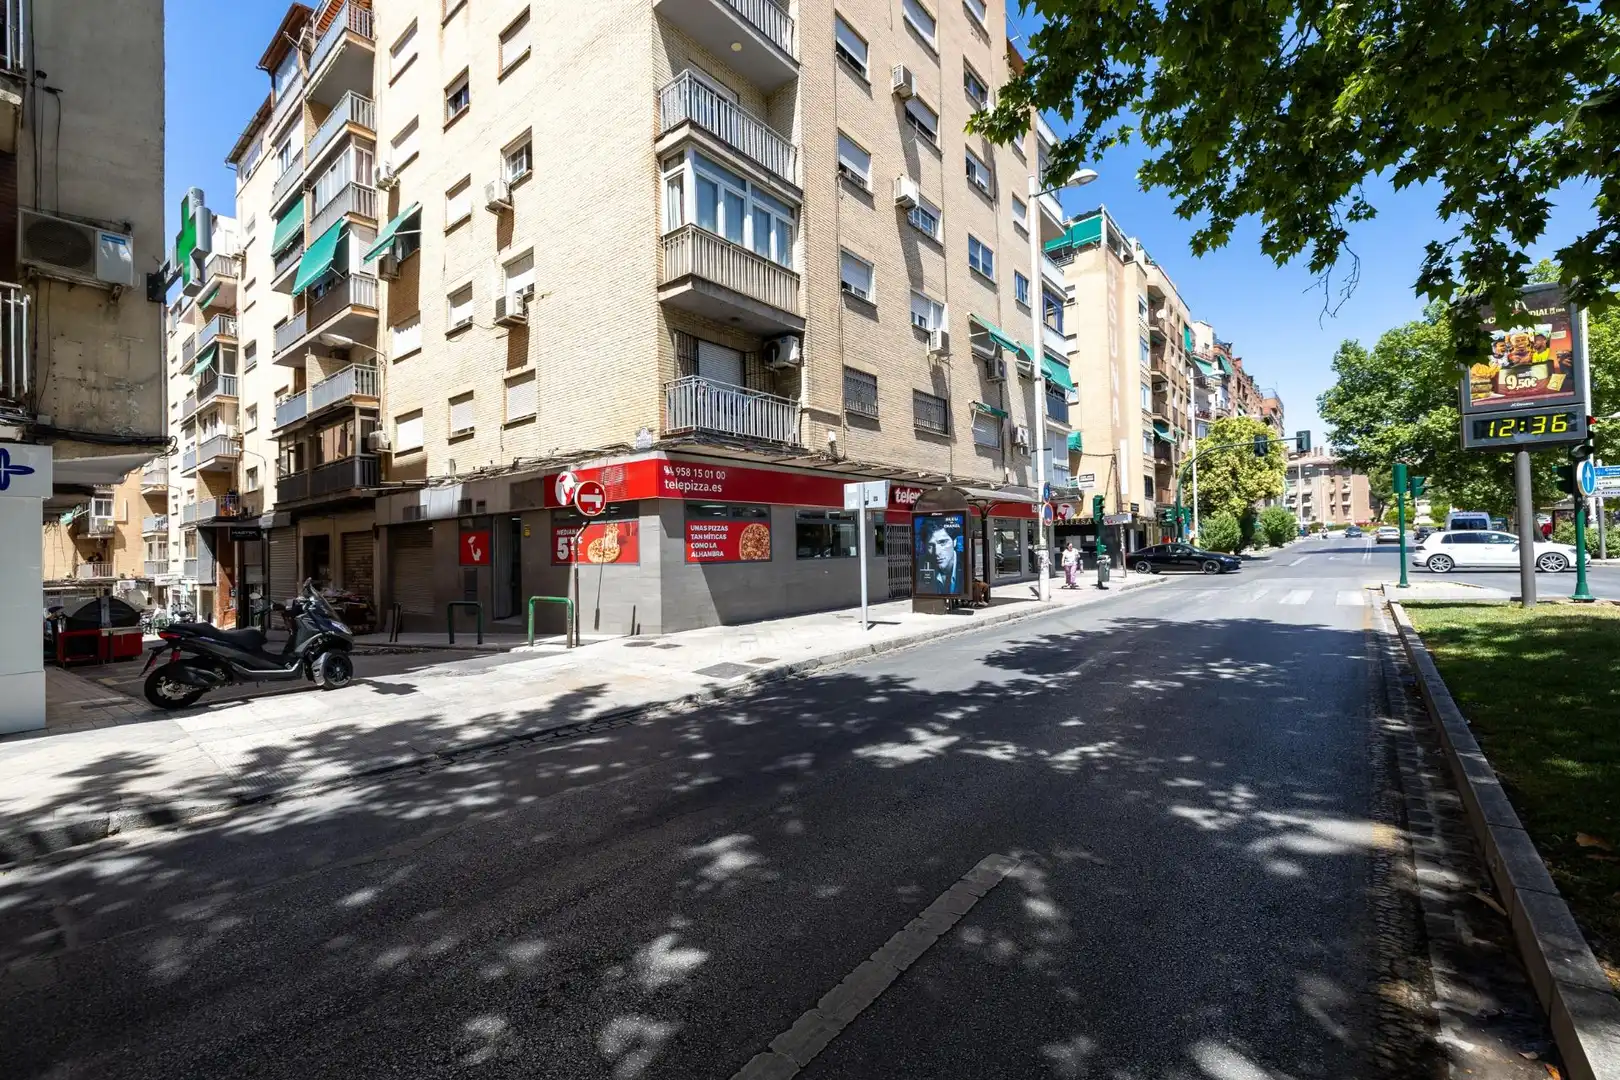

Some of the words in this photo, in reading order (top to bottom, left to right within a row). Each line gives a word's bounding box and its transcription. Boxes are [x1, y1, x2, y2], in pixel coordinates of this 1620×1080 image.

[1506, 374, 1538, 391] 9,50€
[1488, 413, 1568, 438] 12:36
[675, 466, 691, 477] 958
[694, 468, 703, 478] 15
[704, 469, 714, 479] 01
[716, 470, 726, 480] 00
[664, 478, 723, 493] telepizza.es
[690, 524, 708, 532] UNAS
[703, 532, 727, 540] MÍTICAS
[691, 550, 725, 558] ALHAMBRA
